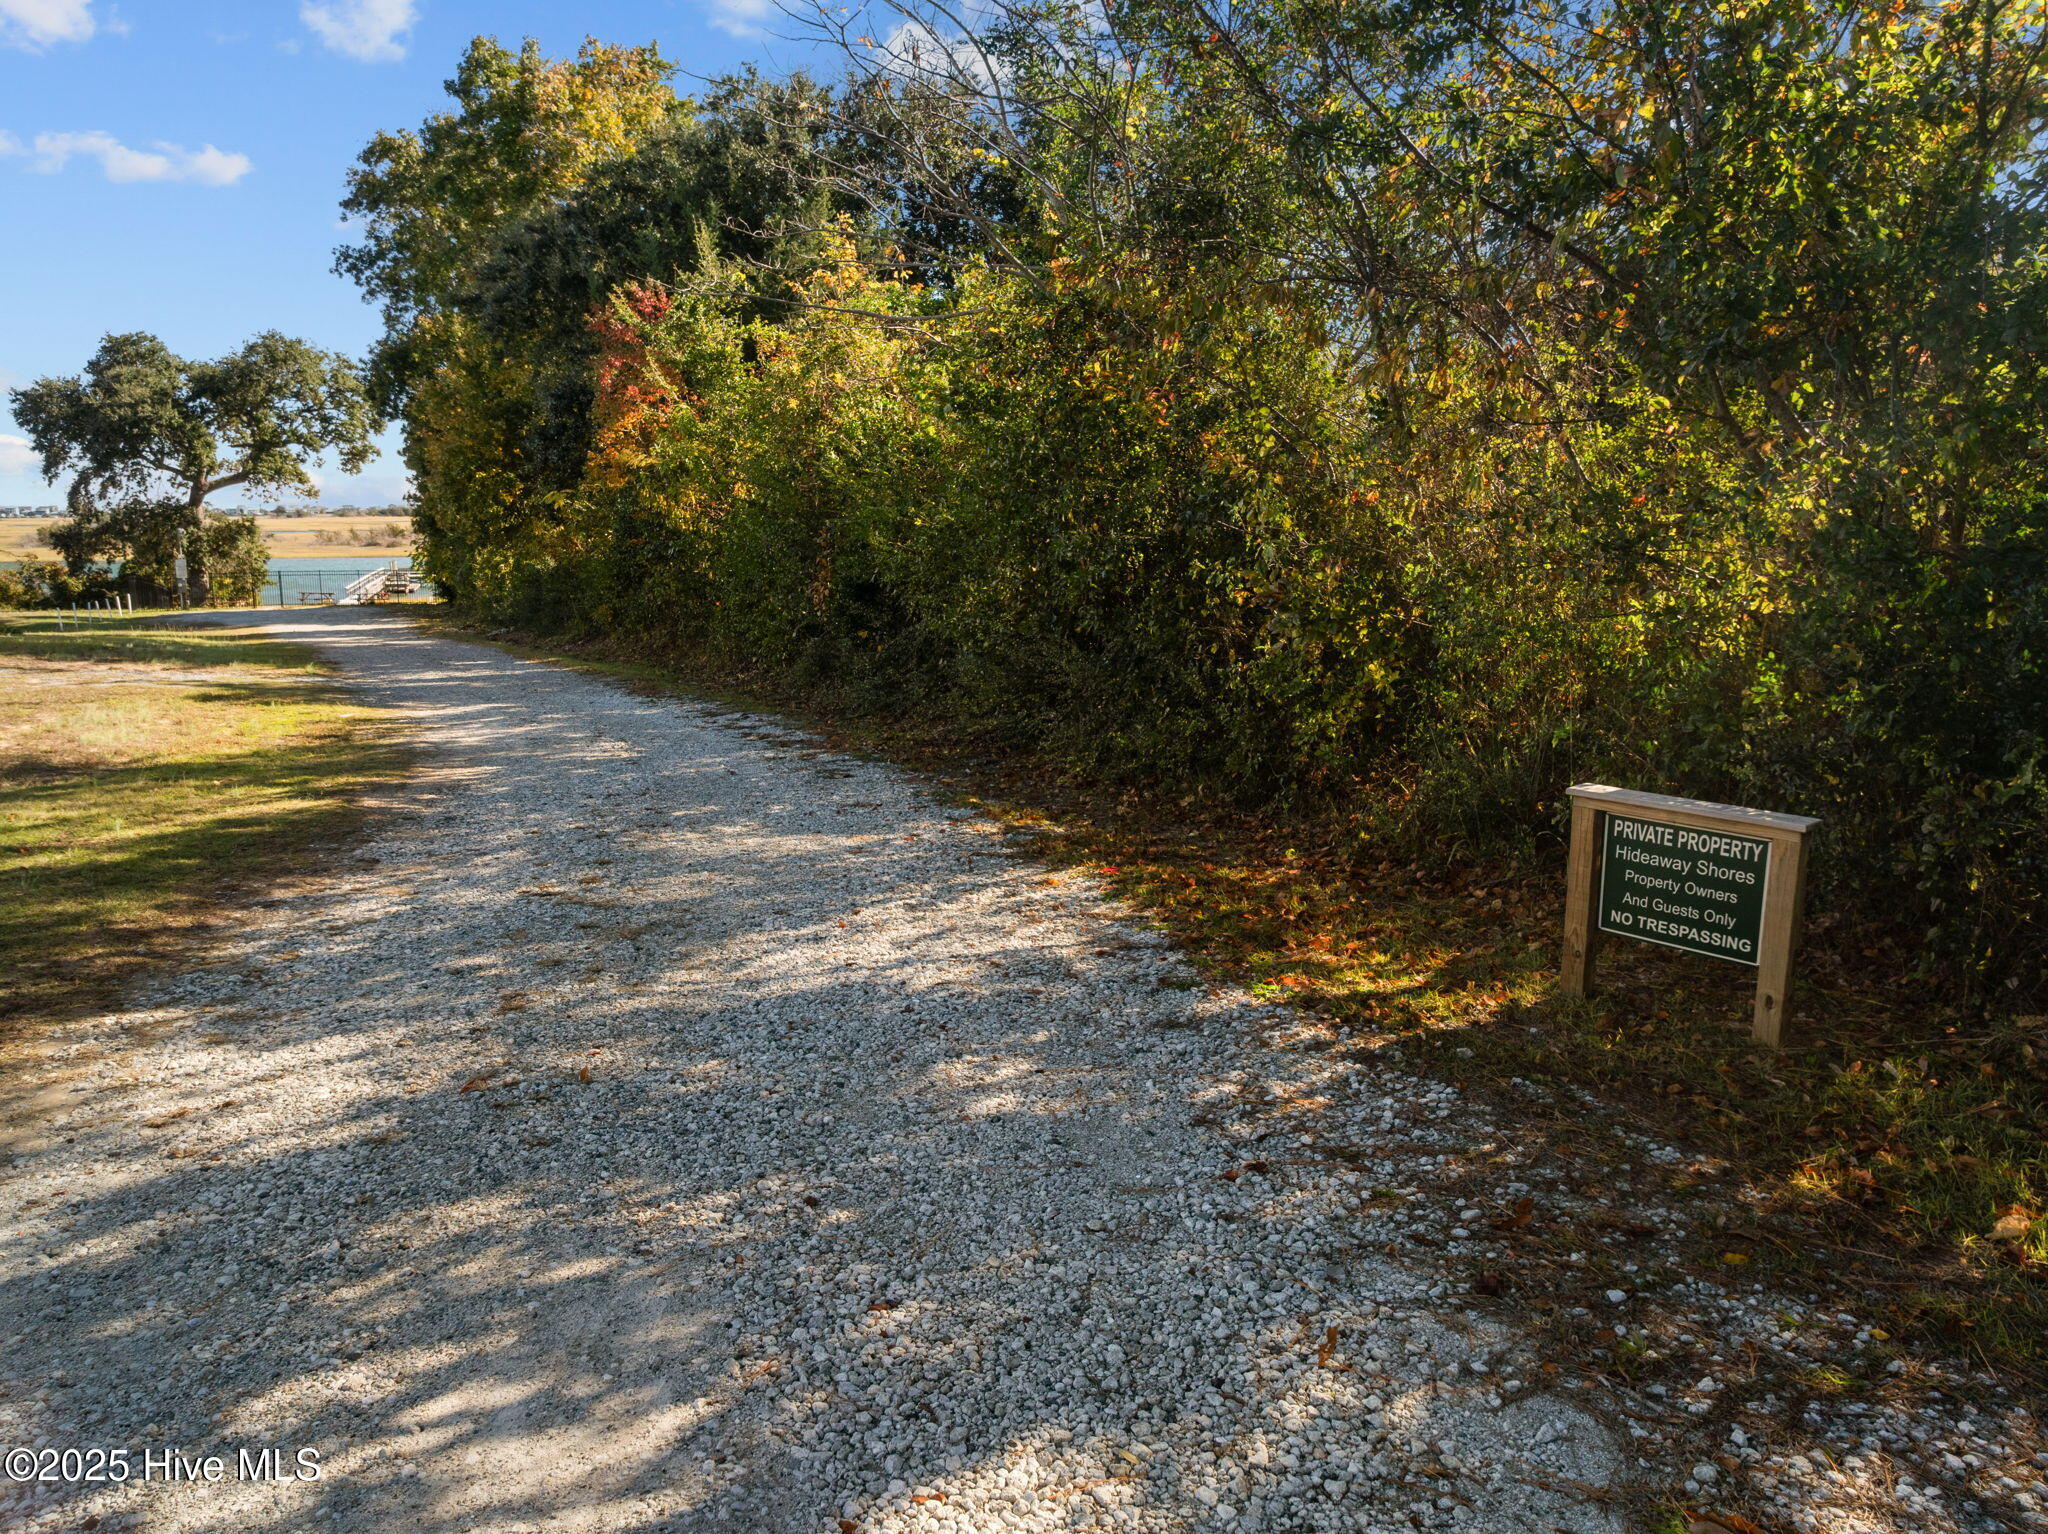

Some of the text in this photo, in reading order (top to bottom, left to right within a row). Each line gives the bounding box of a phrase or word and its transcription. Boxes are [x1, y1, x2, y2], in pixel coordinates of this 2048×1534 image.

[1614, 820, 1763, 862] PRIVATE PROPERTY
[1615, 845, 1755, 885] Hideaway Shores
[1624, 869, 1738, 904] Property Owners
[1622, 892, 1736, 930] And Guests Only
[1610, 910, 1752, 953] NO TRESPASSING
